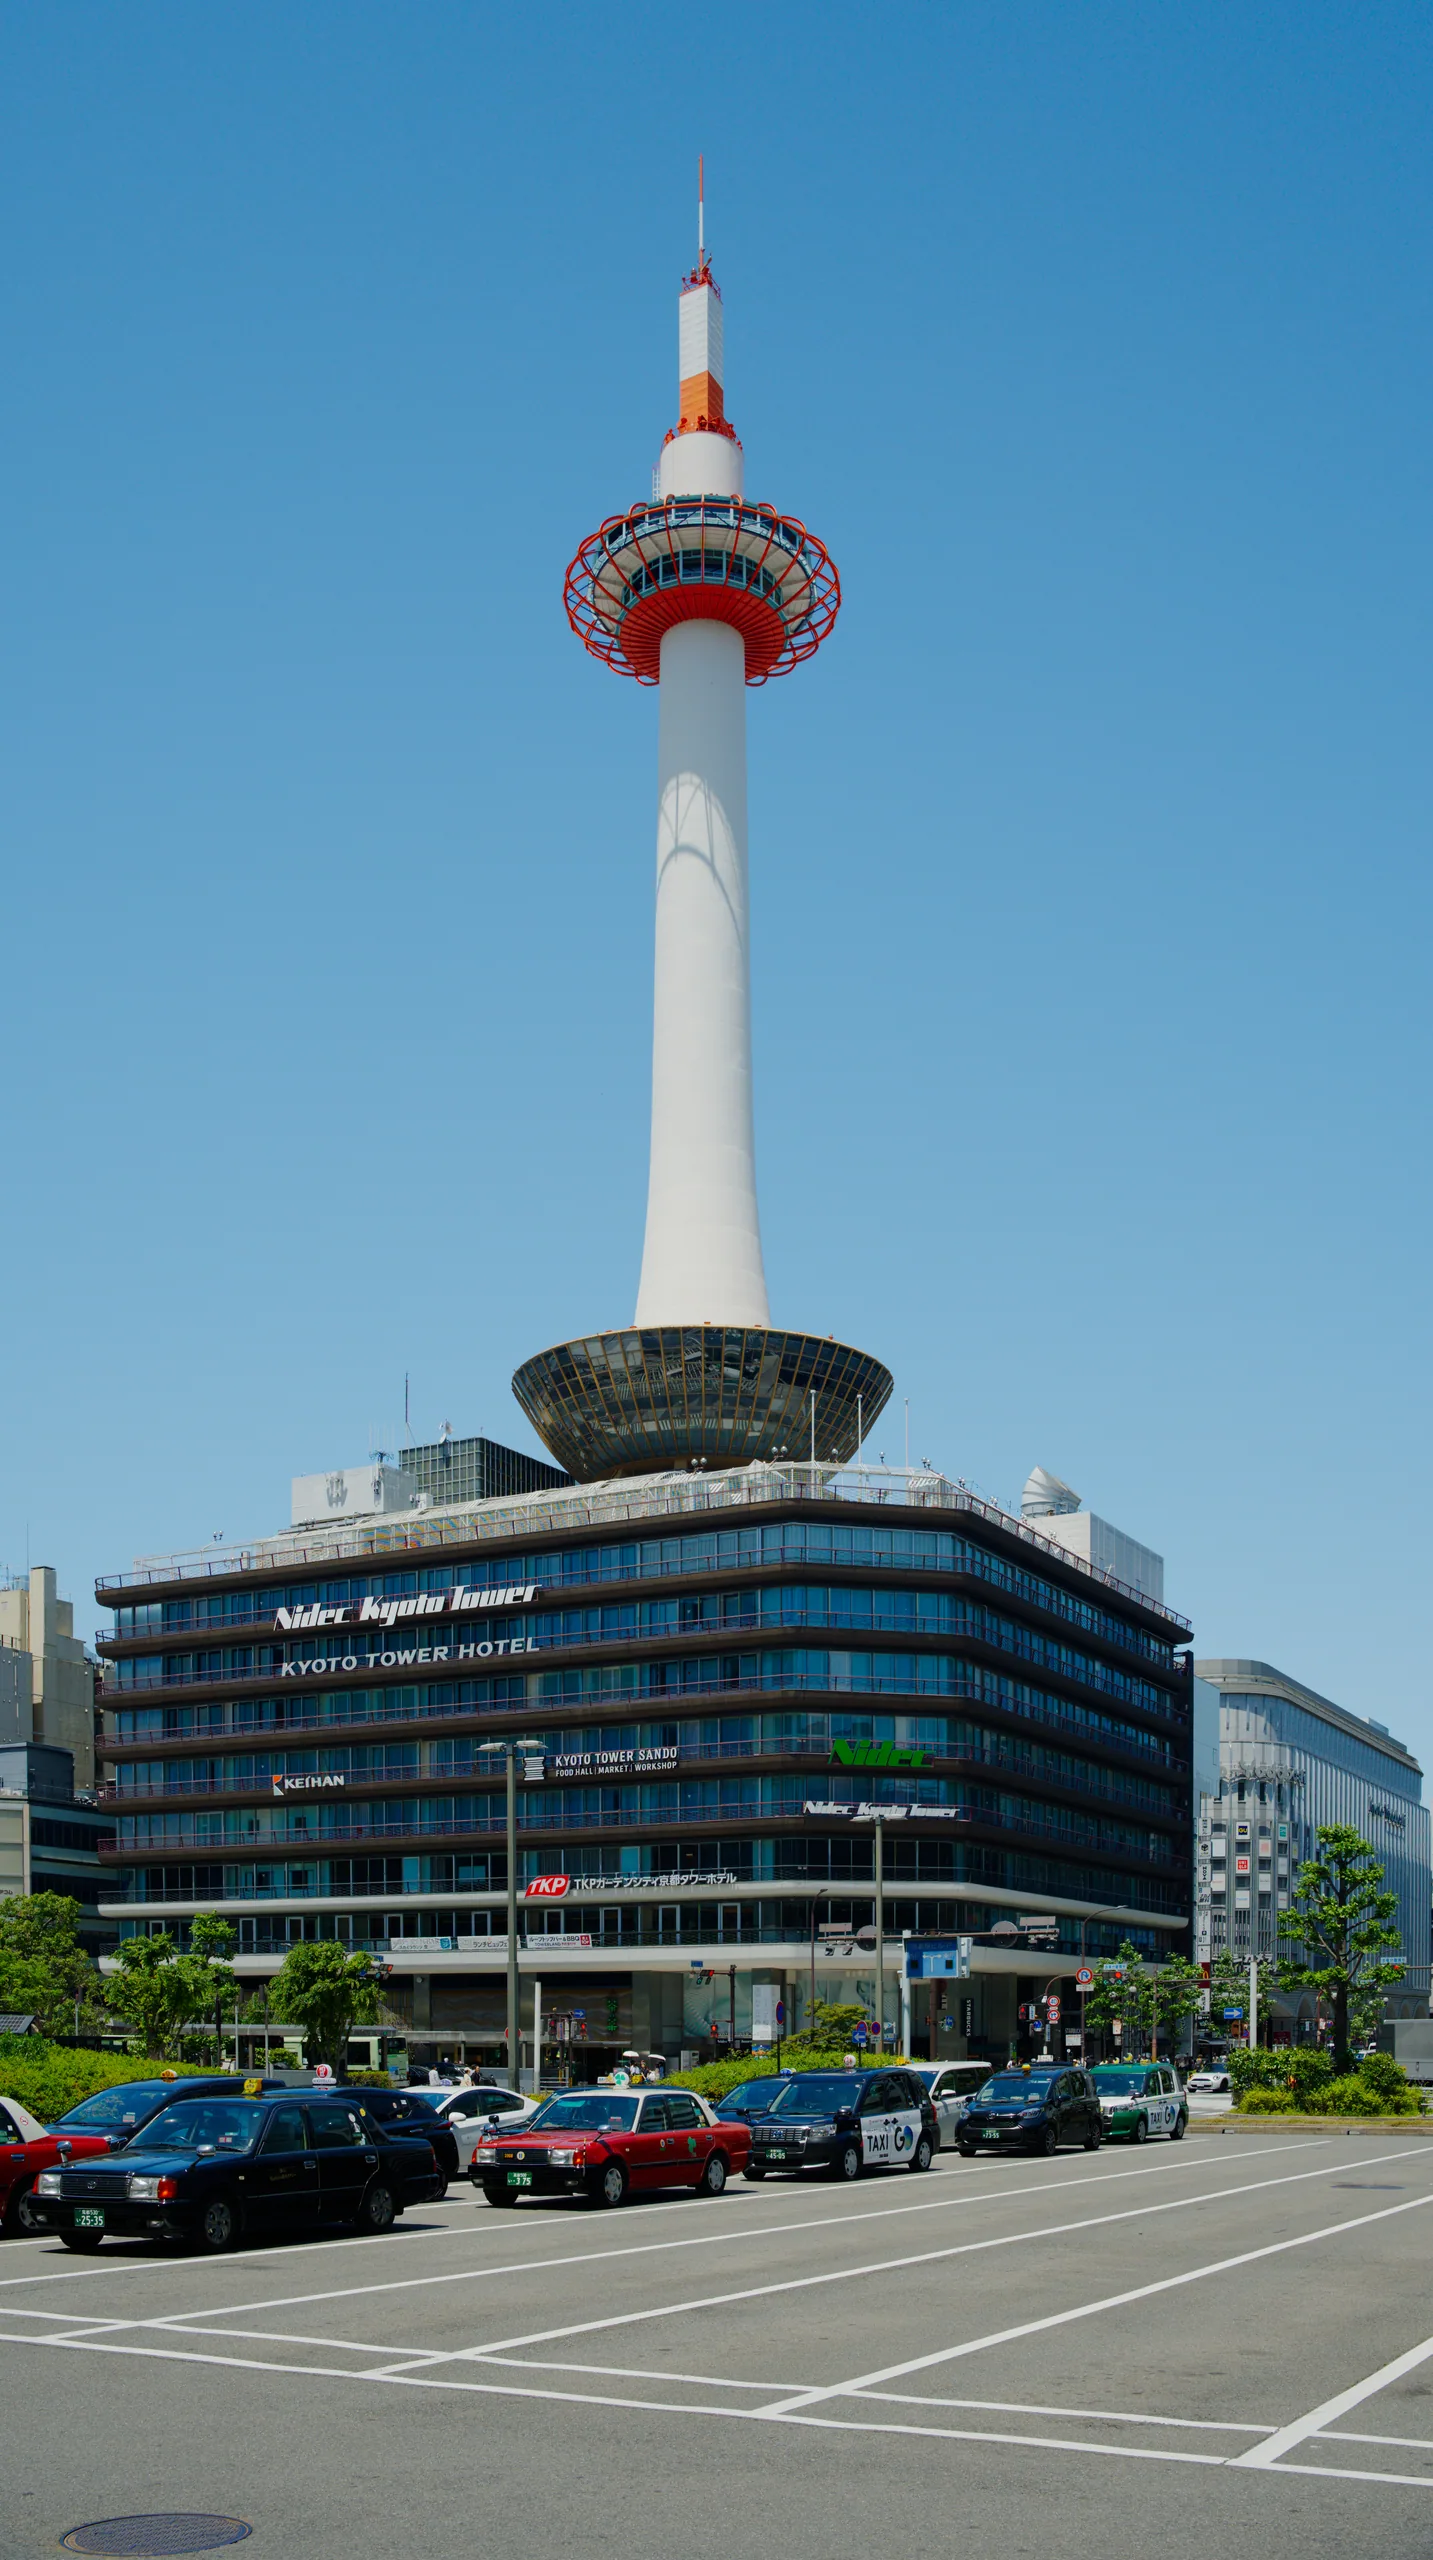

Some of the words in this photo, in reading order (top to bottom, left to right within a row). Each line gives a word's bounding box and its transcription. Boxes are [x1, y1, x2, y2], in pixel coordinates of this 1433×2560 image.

[273, 1602, 353, 1631] Nidec
[359, 1594, 446, 1627] Kyoto
[450, 1584, 542, 1611] Tower
[281, 1655, 357, 1677] KYOTO
[365, 1645, 449, 1668] TOWER
[458, 1637, 540, 1659] HOTEL
[555, 1754, 591, 1767] KYOTO
[594, 1750, 634, 1764] TOWER
[638, 1747, 677, 1761] SANDO
[827, 1739, 936, 1768] Nidec
[555, 1768, 574, 1777] FOOD
[575, 1767, 593, 1776] HALL
[598, 1765, 628, 1775] MARKET
[634, 1761, 677, 1772] WORKSHOP
[284, 1775, 345, 1789] KEIHAN
[803, 1801, 855, 1815] Nidec
[909, 1803, 961, 1818] Tower
[529, 1877, 568, 1895] TKP
[574, 1872, 738, 1890] TKPガーデンシティ京都タワーホテル
[867, 2134, 888, 2152] TAXI
[81, 2215, 104, 2226] 25-35
